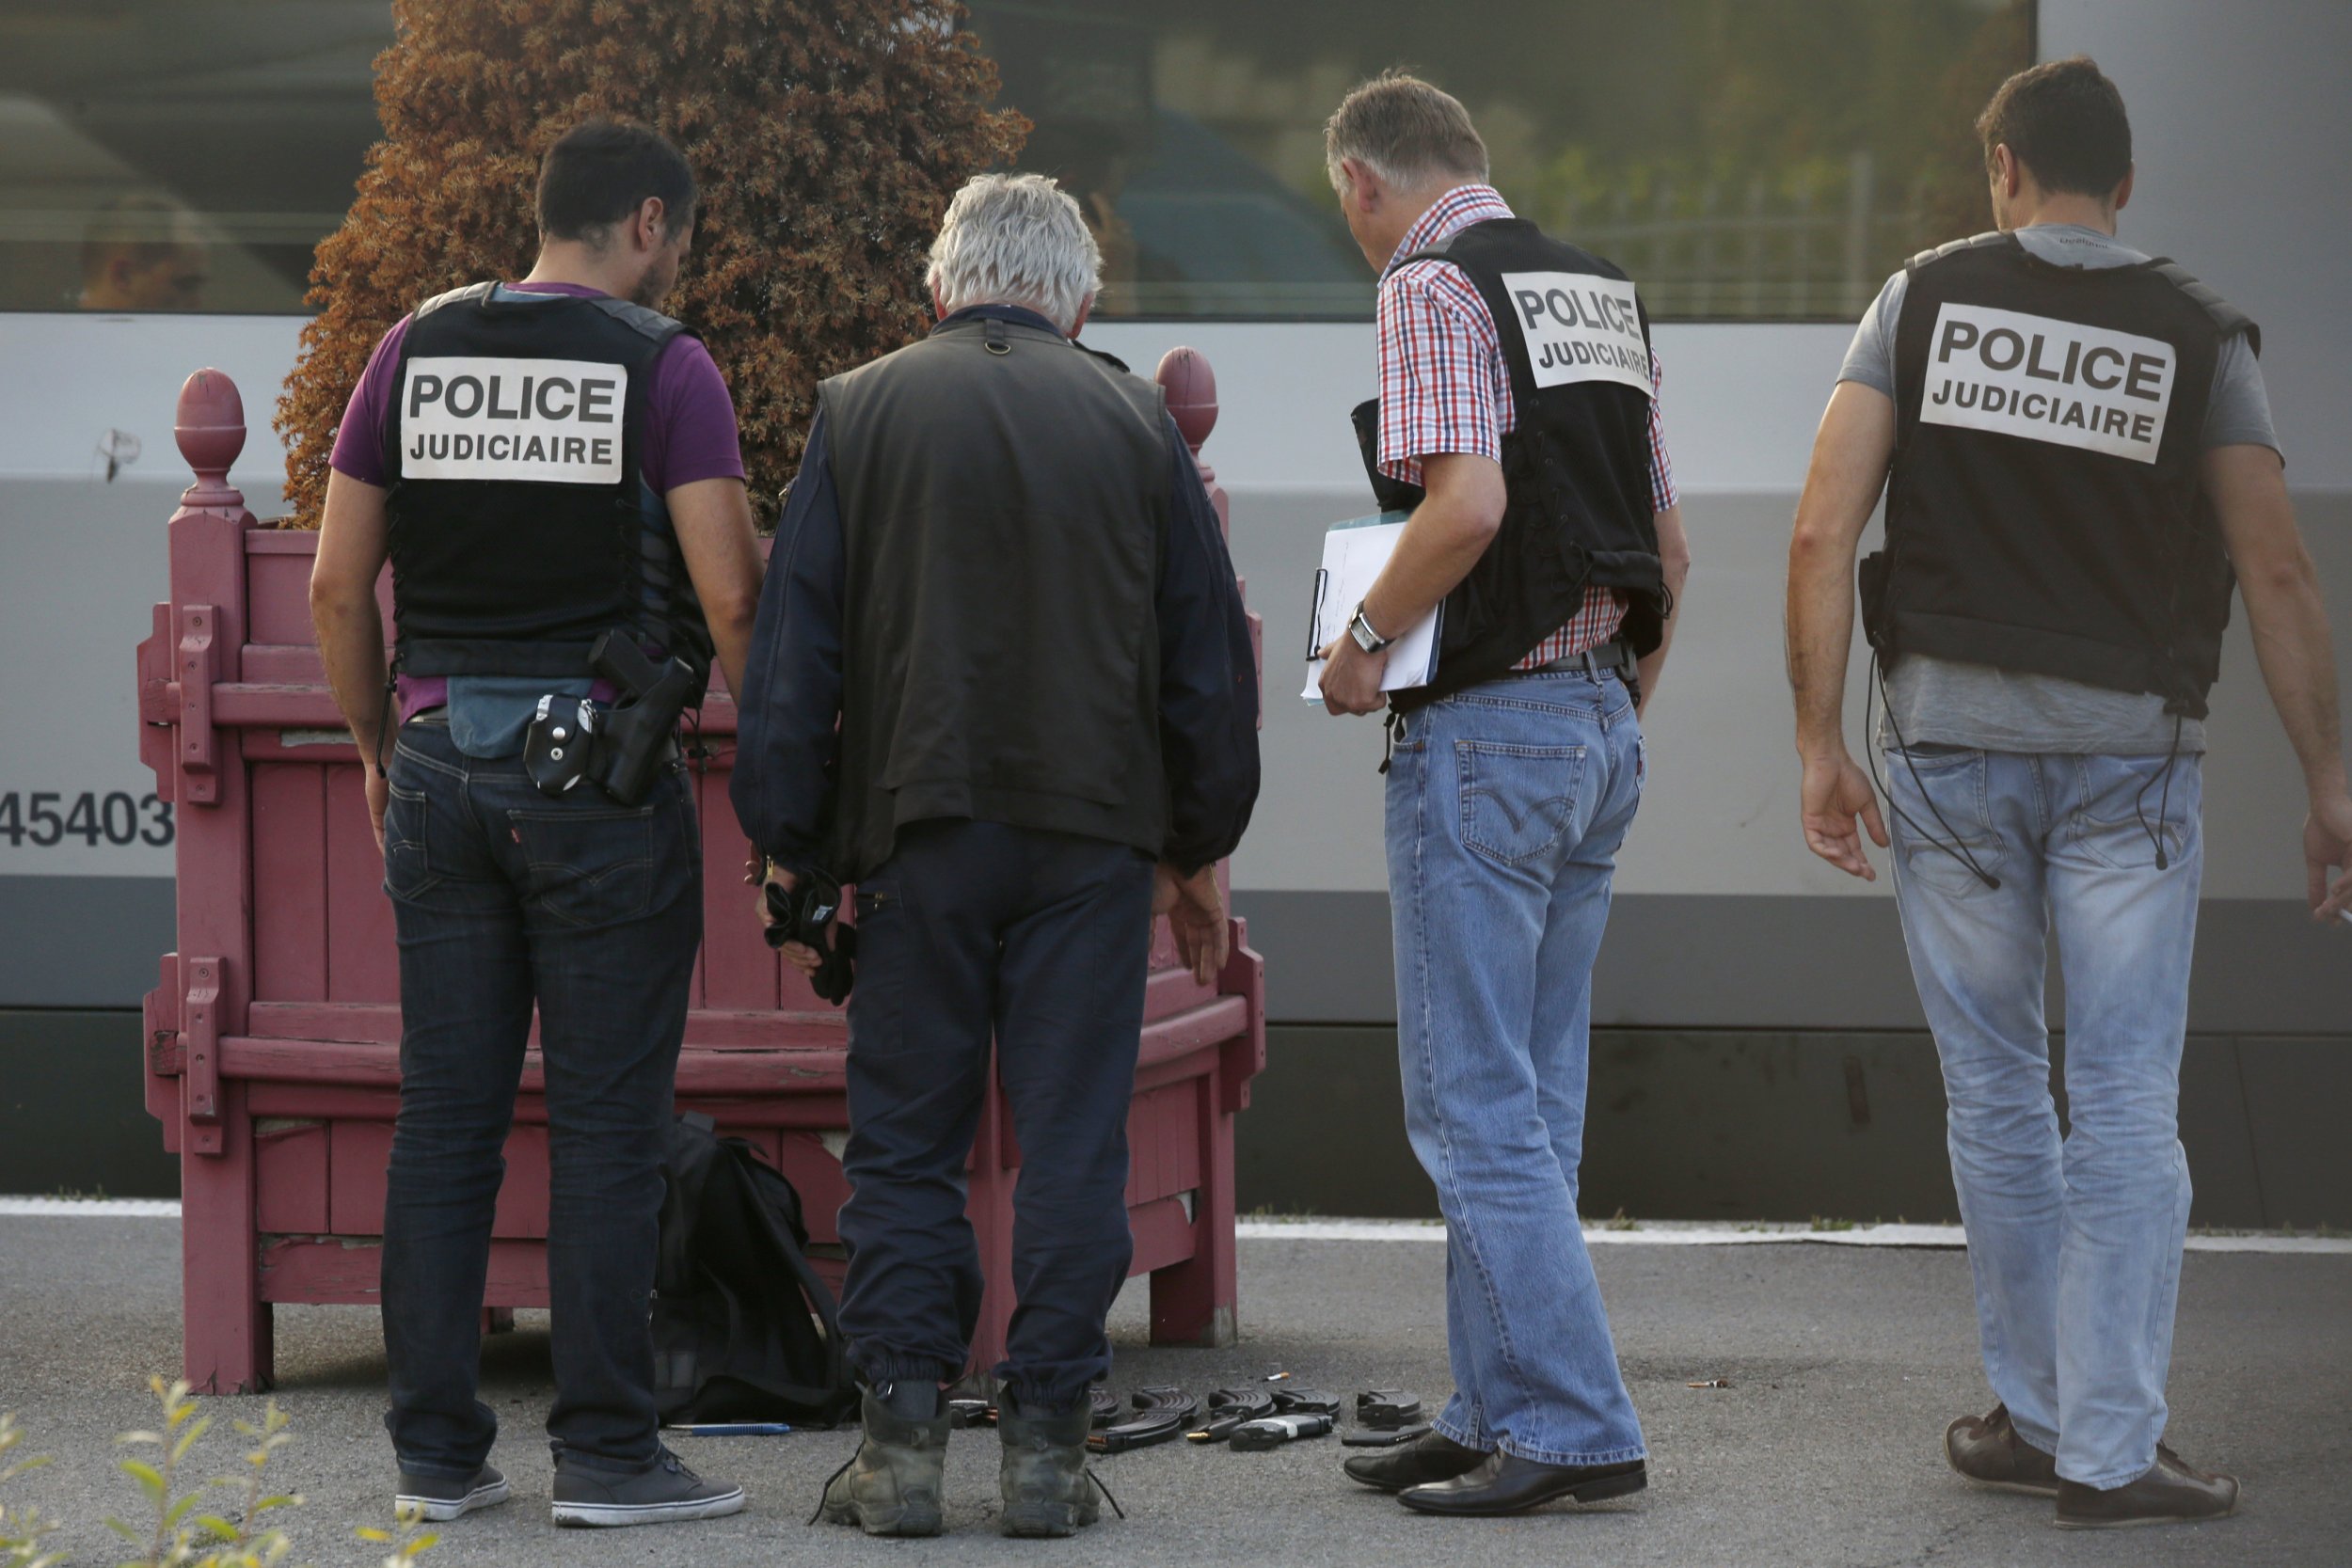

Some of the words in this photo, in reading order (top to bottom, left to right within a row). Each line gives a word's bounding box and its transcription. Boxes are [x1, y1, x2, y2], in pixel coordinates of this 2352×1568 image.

[1514, 288, 1642, 341] POLICE
[1538, 341, 1650, 382] JUDICIAIRE
[1937, 320, 2167, 403] POLICE
[409, 374, 616, 423] POLICE
[1931, 379, 2155, 444] JUDICIAIRE
[409, 434, 612, 466] JUDICIAIRE
[0, 791, 176, 847] 45403
